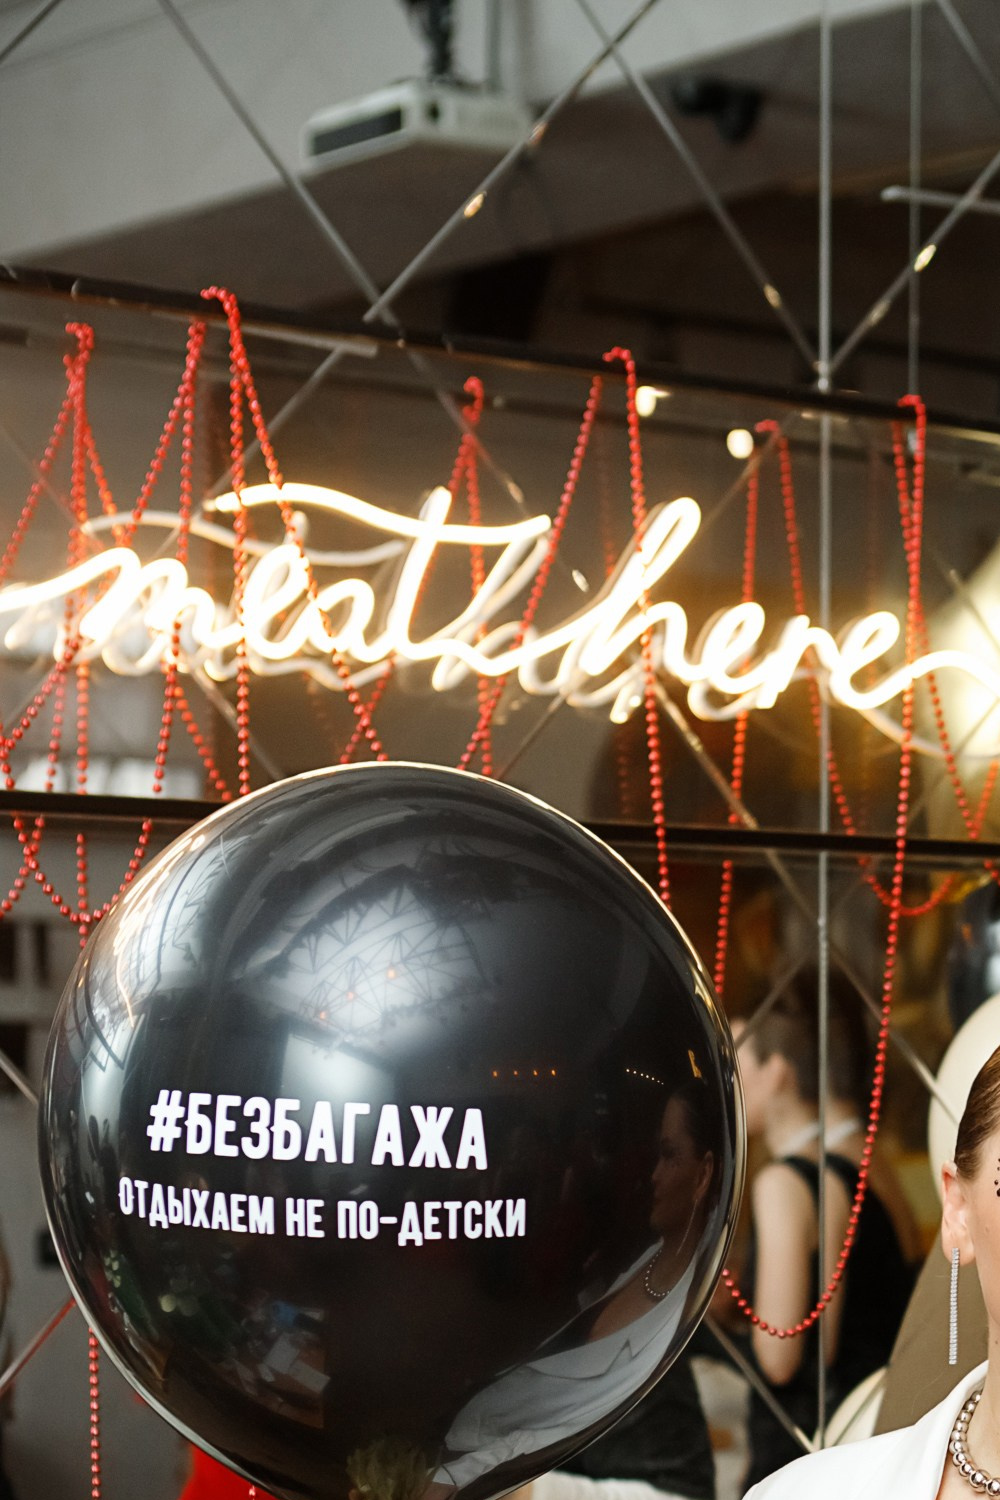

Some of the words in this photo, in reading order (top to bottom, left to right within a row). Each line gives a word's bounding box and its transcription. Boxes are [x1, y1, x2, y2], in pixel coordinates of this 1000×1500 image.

[0, 483, 551, 666] meat
[146, 1089, 488, 1170] #БЕЗБАГАЖА
[118, 1176, 275, 1235] ОТДЫХАЕМ
[285, 1198, 325, 1238] НЕ
[337, 1198, 526, 1247] ПО-ДЕТСКИ
